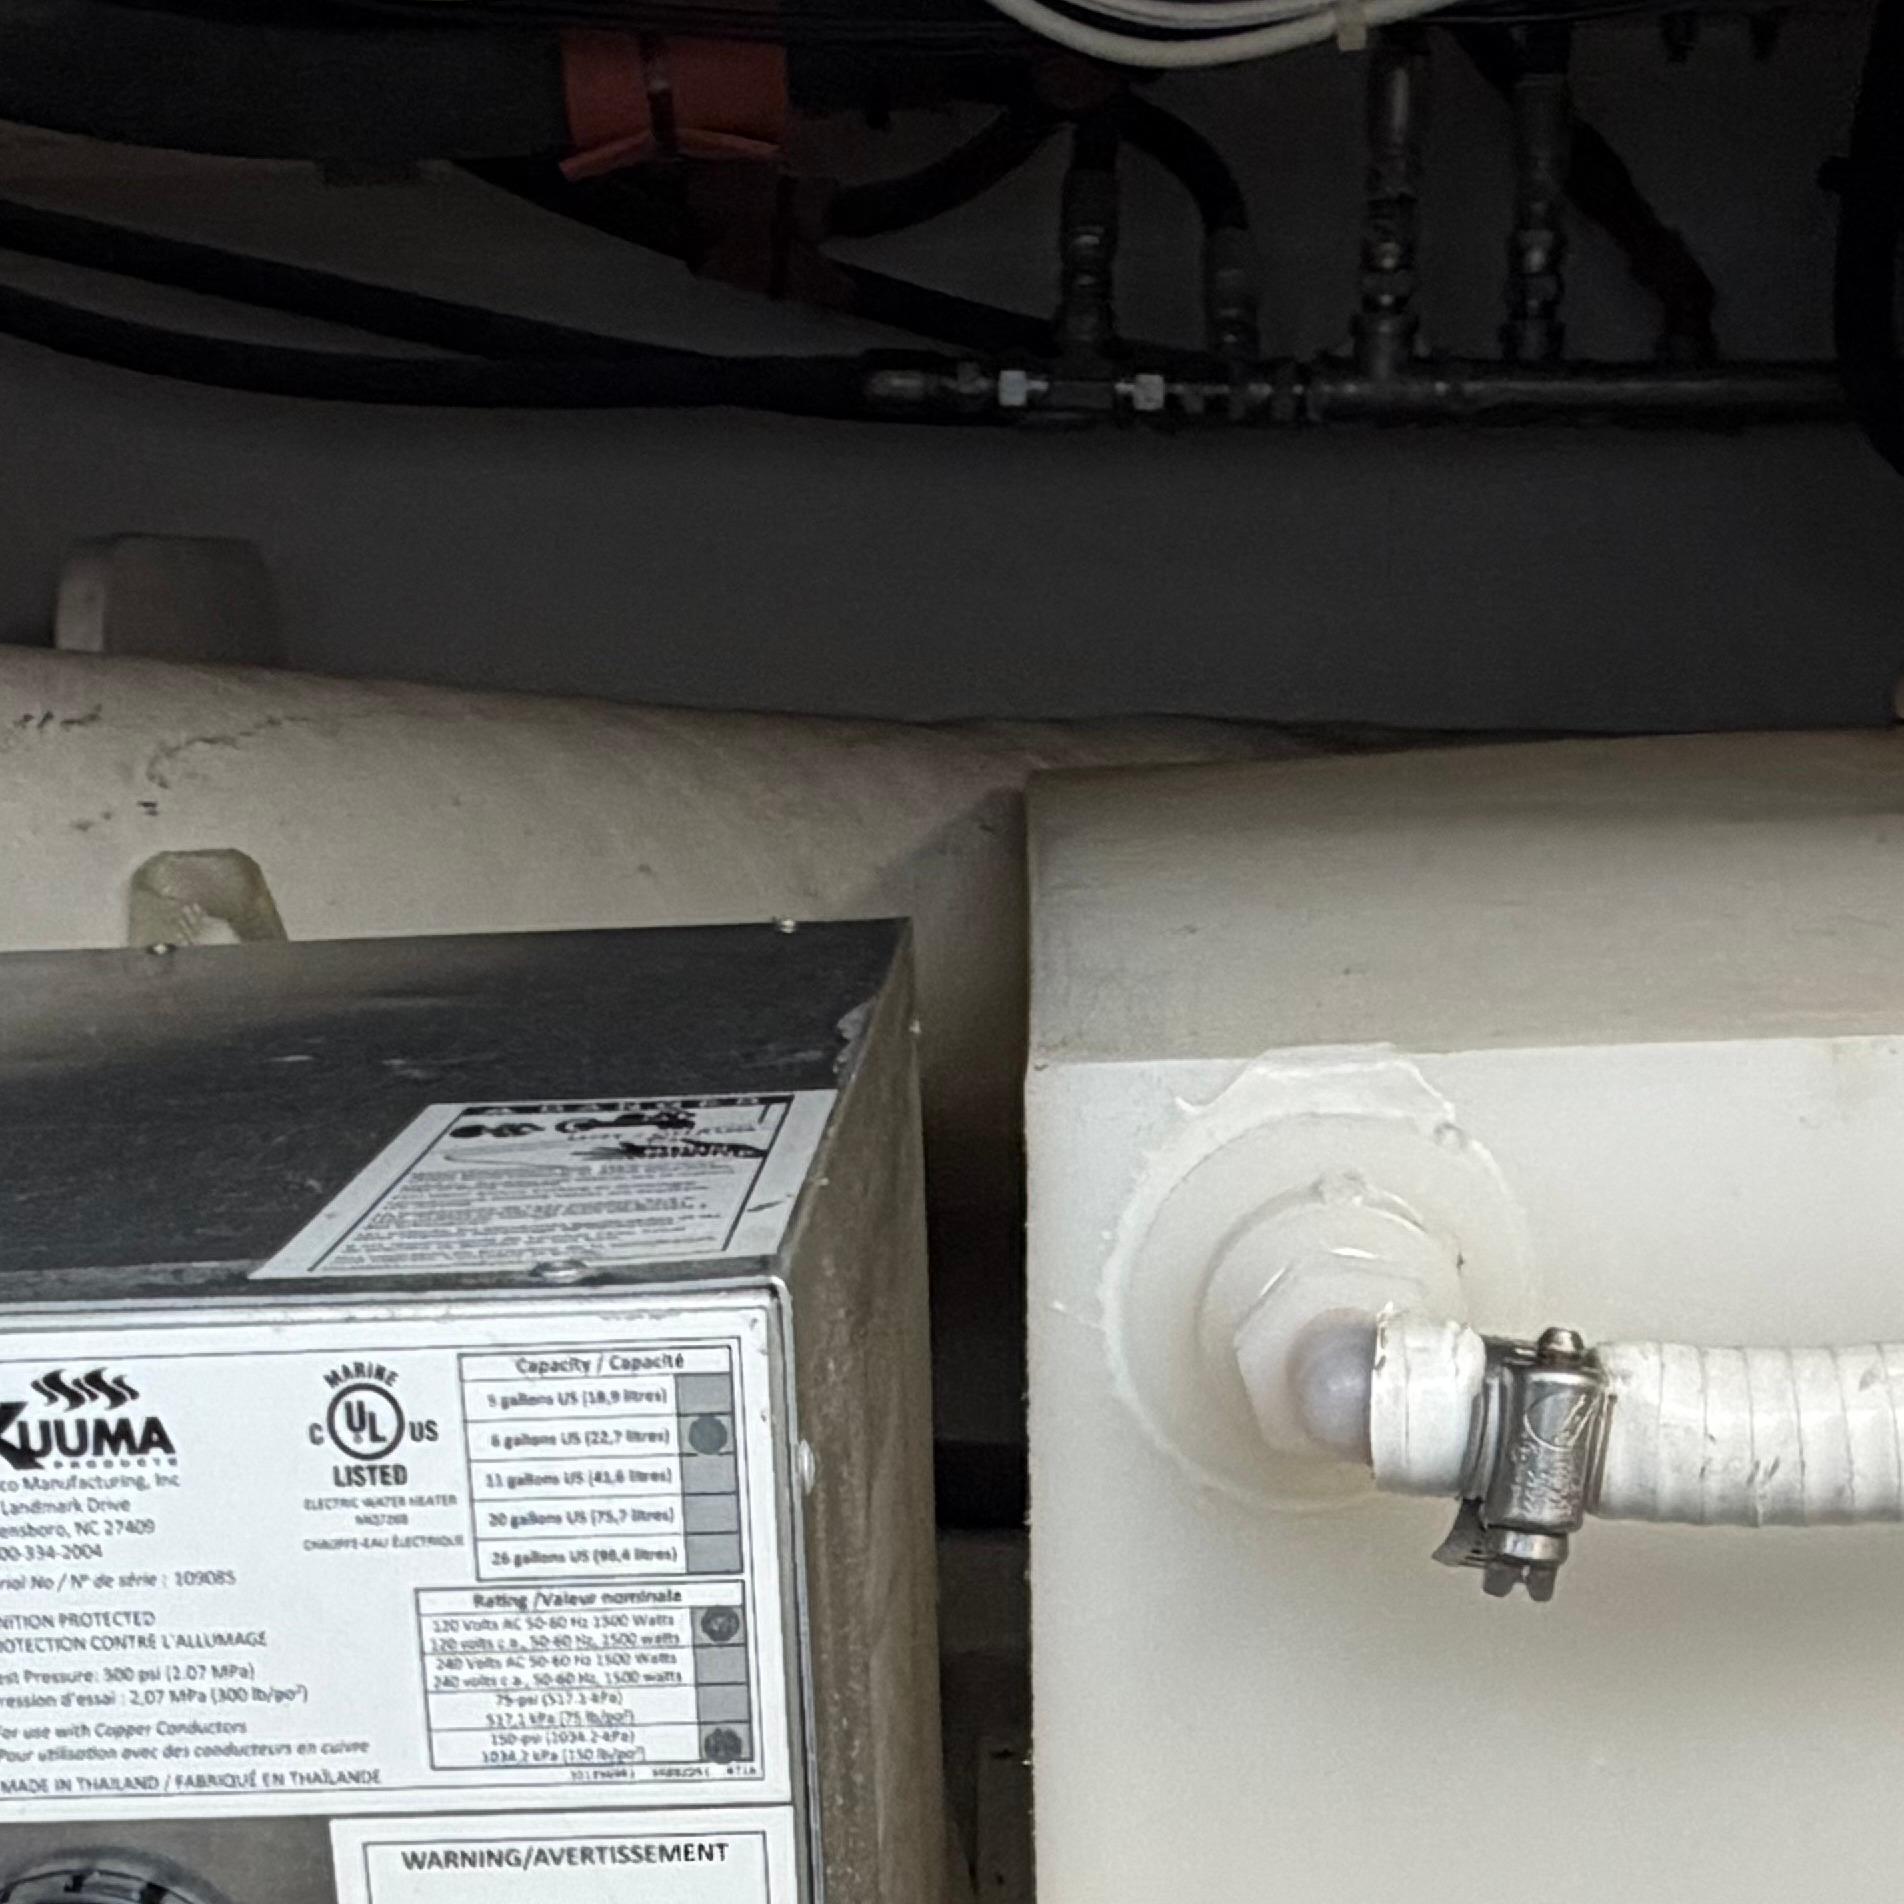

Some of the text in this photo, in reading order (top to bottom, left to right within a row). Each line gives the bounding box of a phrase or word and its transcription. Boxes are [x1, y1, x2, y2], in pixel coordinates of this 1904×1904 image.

[323, 1361, 398, 1390] MARINE
[514, 1356, 591, 1376] Capacity
[608, 1353, 684, 1372] Capacité
[344, 1400, 386, 1443] UL
[409, 1419, 439, 1442] US
[22, 1474, 151, 1492] Manufacturing,
[154, 1472, 181, 1488] Inc
[333, 1463, 408, 1488] LISTED
[0, 1497, 83, 1517] Landmark
[86, 1497, 131, 1514] Drive
[74, 1519, 99, 1536] NC
[104, 1518, 156, 1536] 27409
[401, 1842, 728, 1871] WARNING/AVERTISSEMENT
